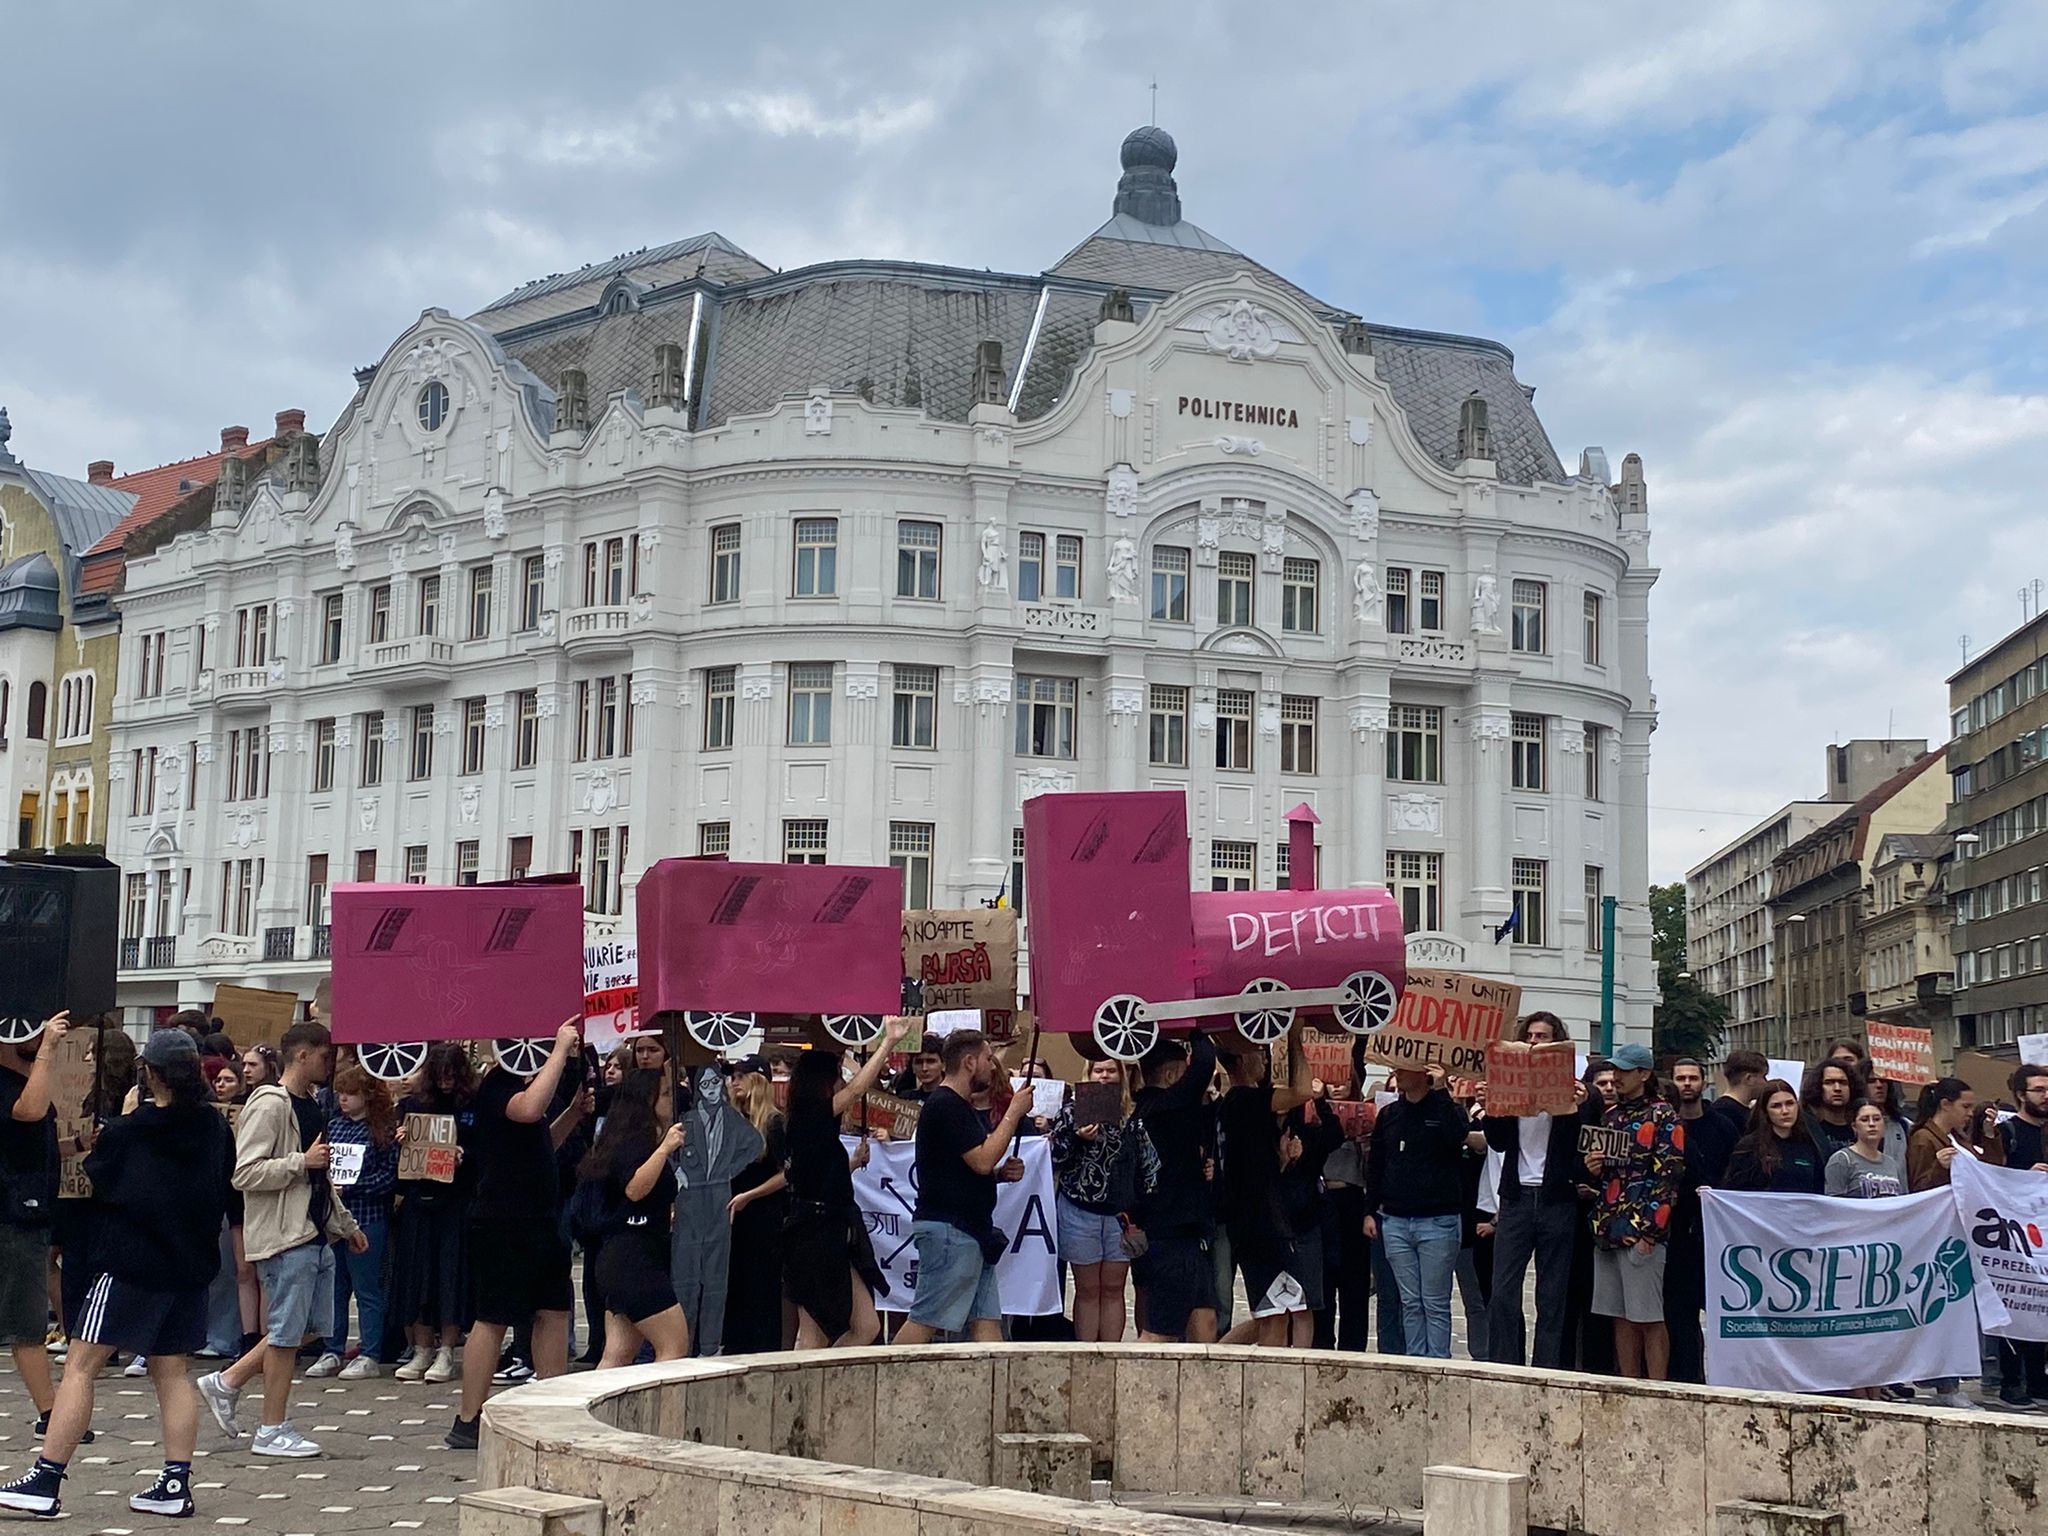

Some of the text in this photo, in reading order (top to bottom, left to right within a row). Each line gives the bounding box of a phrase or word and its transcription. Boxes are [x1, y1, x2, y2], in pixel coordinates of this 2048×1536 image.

[1178, 396, 1299, 429] POLITEHNICA
[913, 920, 974, 942] NOAPTE
[1226, 904, 1383, 957] DEFICIT
[921, 941, 992, 987] BURSĂ
[1389, 991, 1505, 1048] TUDENȚII
[429, 1117, 456, 1144] NET
[1580, 1127, 1629, 1159] DESTUL!
[1720, 1242, 1902, 1313] SSFB
